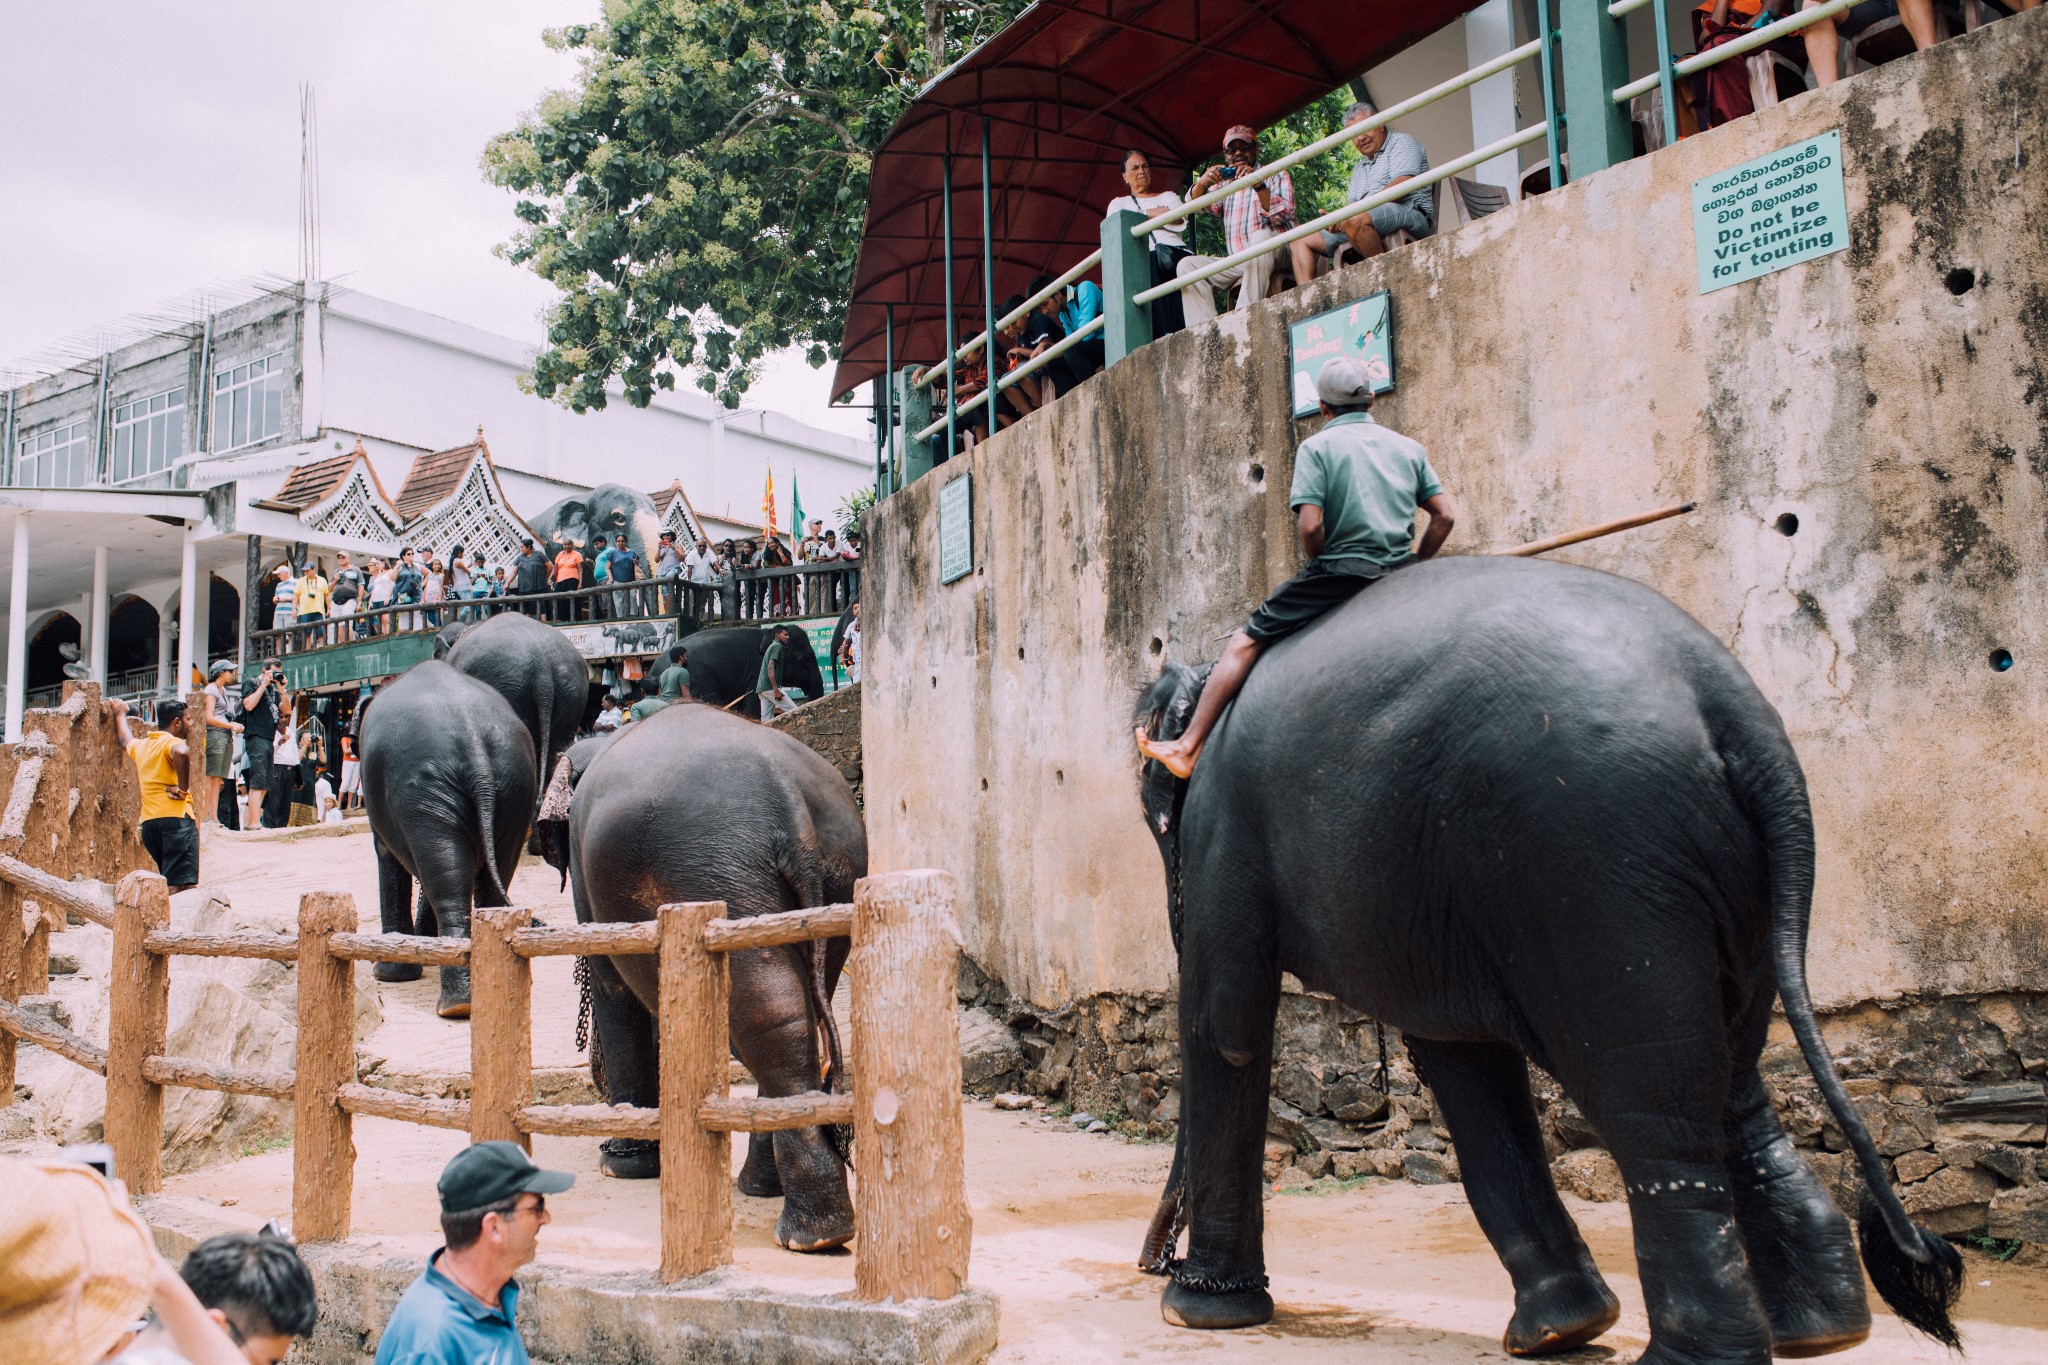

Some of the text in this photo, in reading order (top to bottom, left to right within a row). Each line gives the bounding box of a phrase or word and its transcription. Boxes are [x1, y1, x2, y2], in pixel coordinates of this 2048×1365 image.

[1717, 182, 1818, 224] වග බලාගන්න
[1718, 201, 1819, 244] Do not be
[1712, 231, 1833, 279] for touting
[1713, 215, 1828, 260] Victimize
